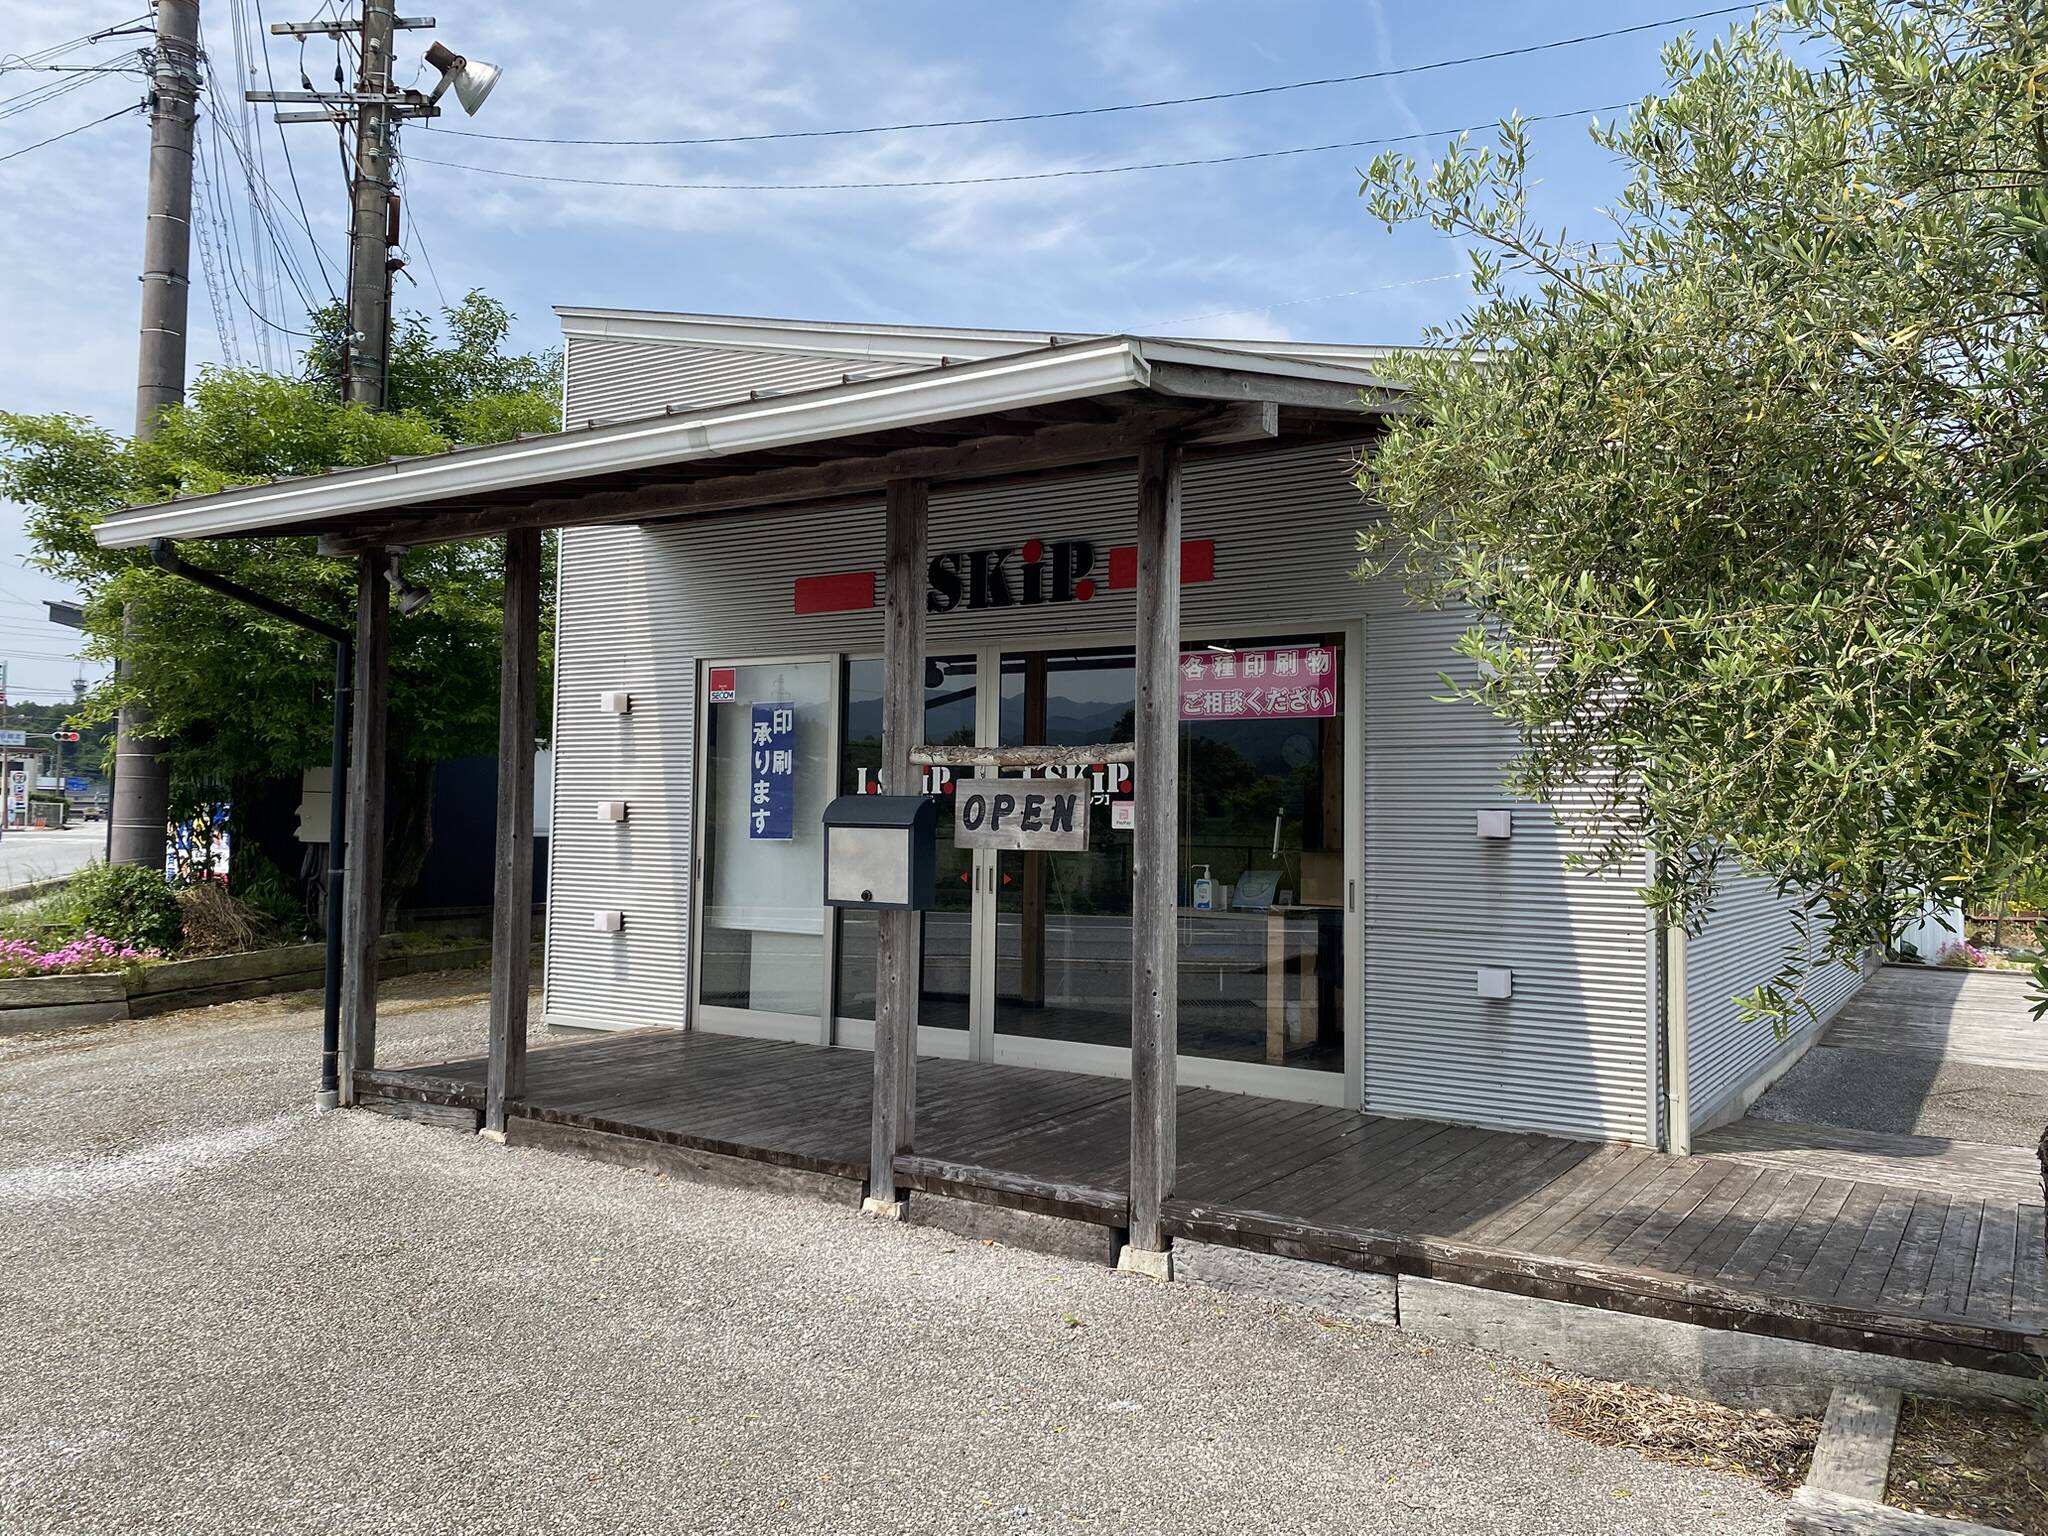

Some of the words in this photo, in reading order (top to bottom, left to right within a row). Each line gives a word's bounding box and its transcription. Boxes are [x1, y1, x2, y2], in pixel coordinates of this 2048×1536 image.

[1182, 649, 1331, 680] 各種印刷物
[711, 691, 735, 700] SECOM
[1183, 687, 1333, 715] ご相談ください
[772, 709, 793, 775] 印刷
[752, 722, 773, 834] 承ります
[963, 794, 1076, 832] OPEN
